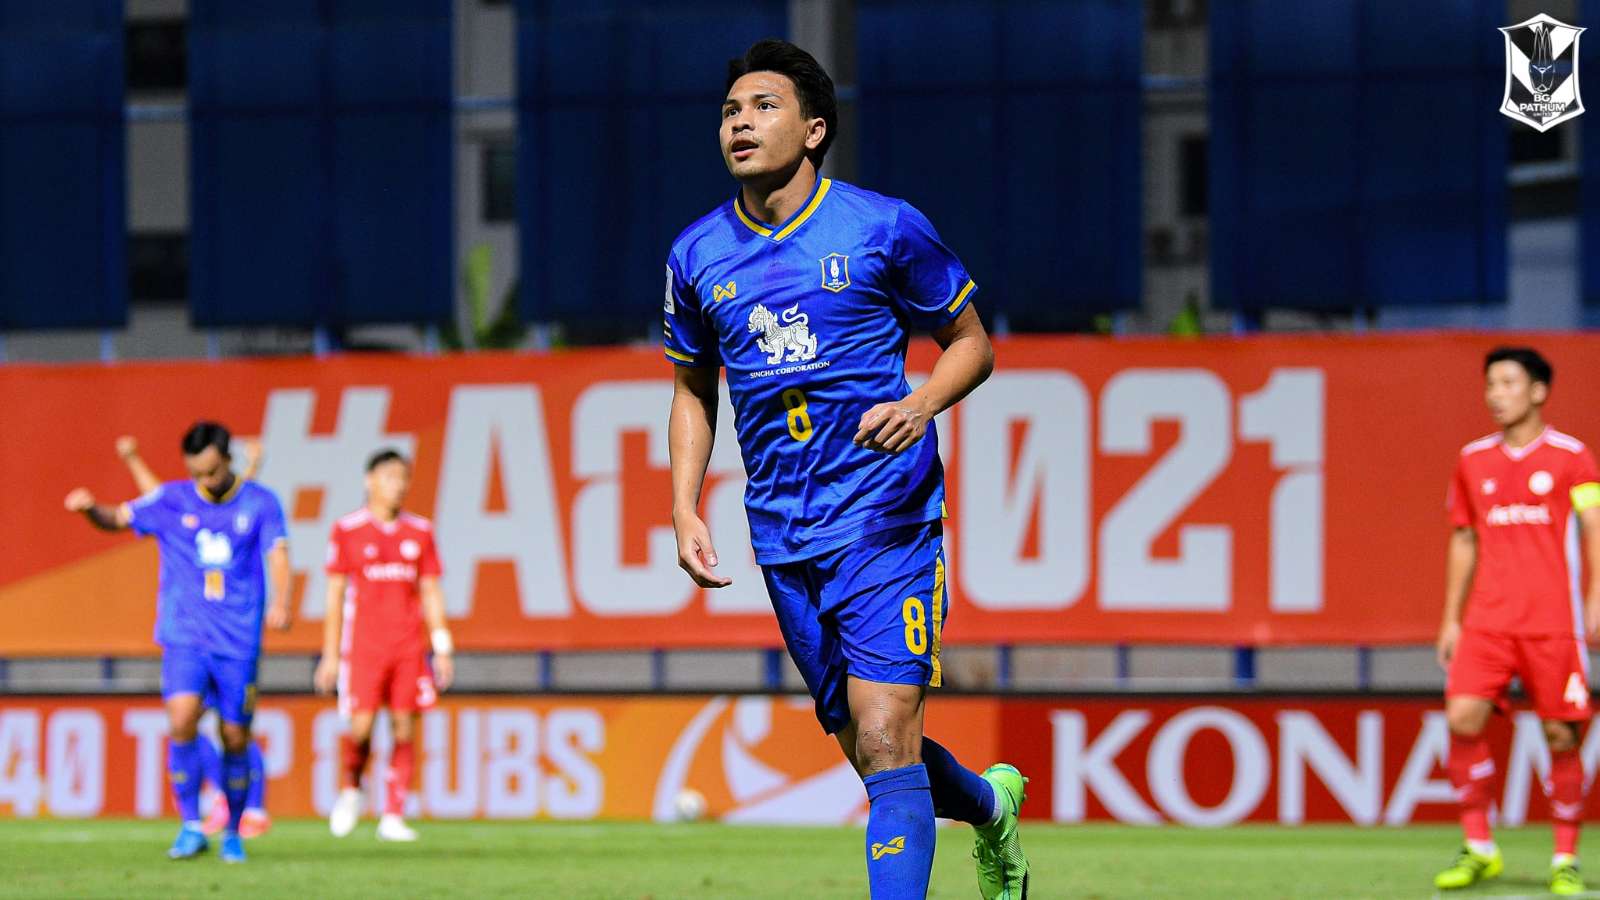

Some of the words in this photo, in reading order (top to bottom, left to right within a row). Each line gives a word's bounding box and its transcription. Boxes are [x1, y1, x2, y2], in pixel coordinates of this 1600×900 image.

[750, 369, 775, 379] SINGHA
[775, 361, 831, 375] CORPORATION
[782, 388, 813, 442] 8
[902, 596, 928, 656] 8
